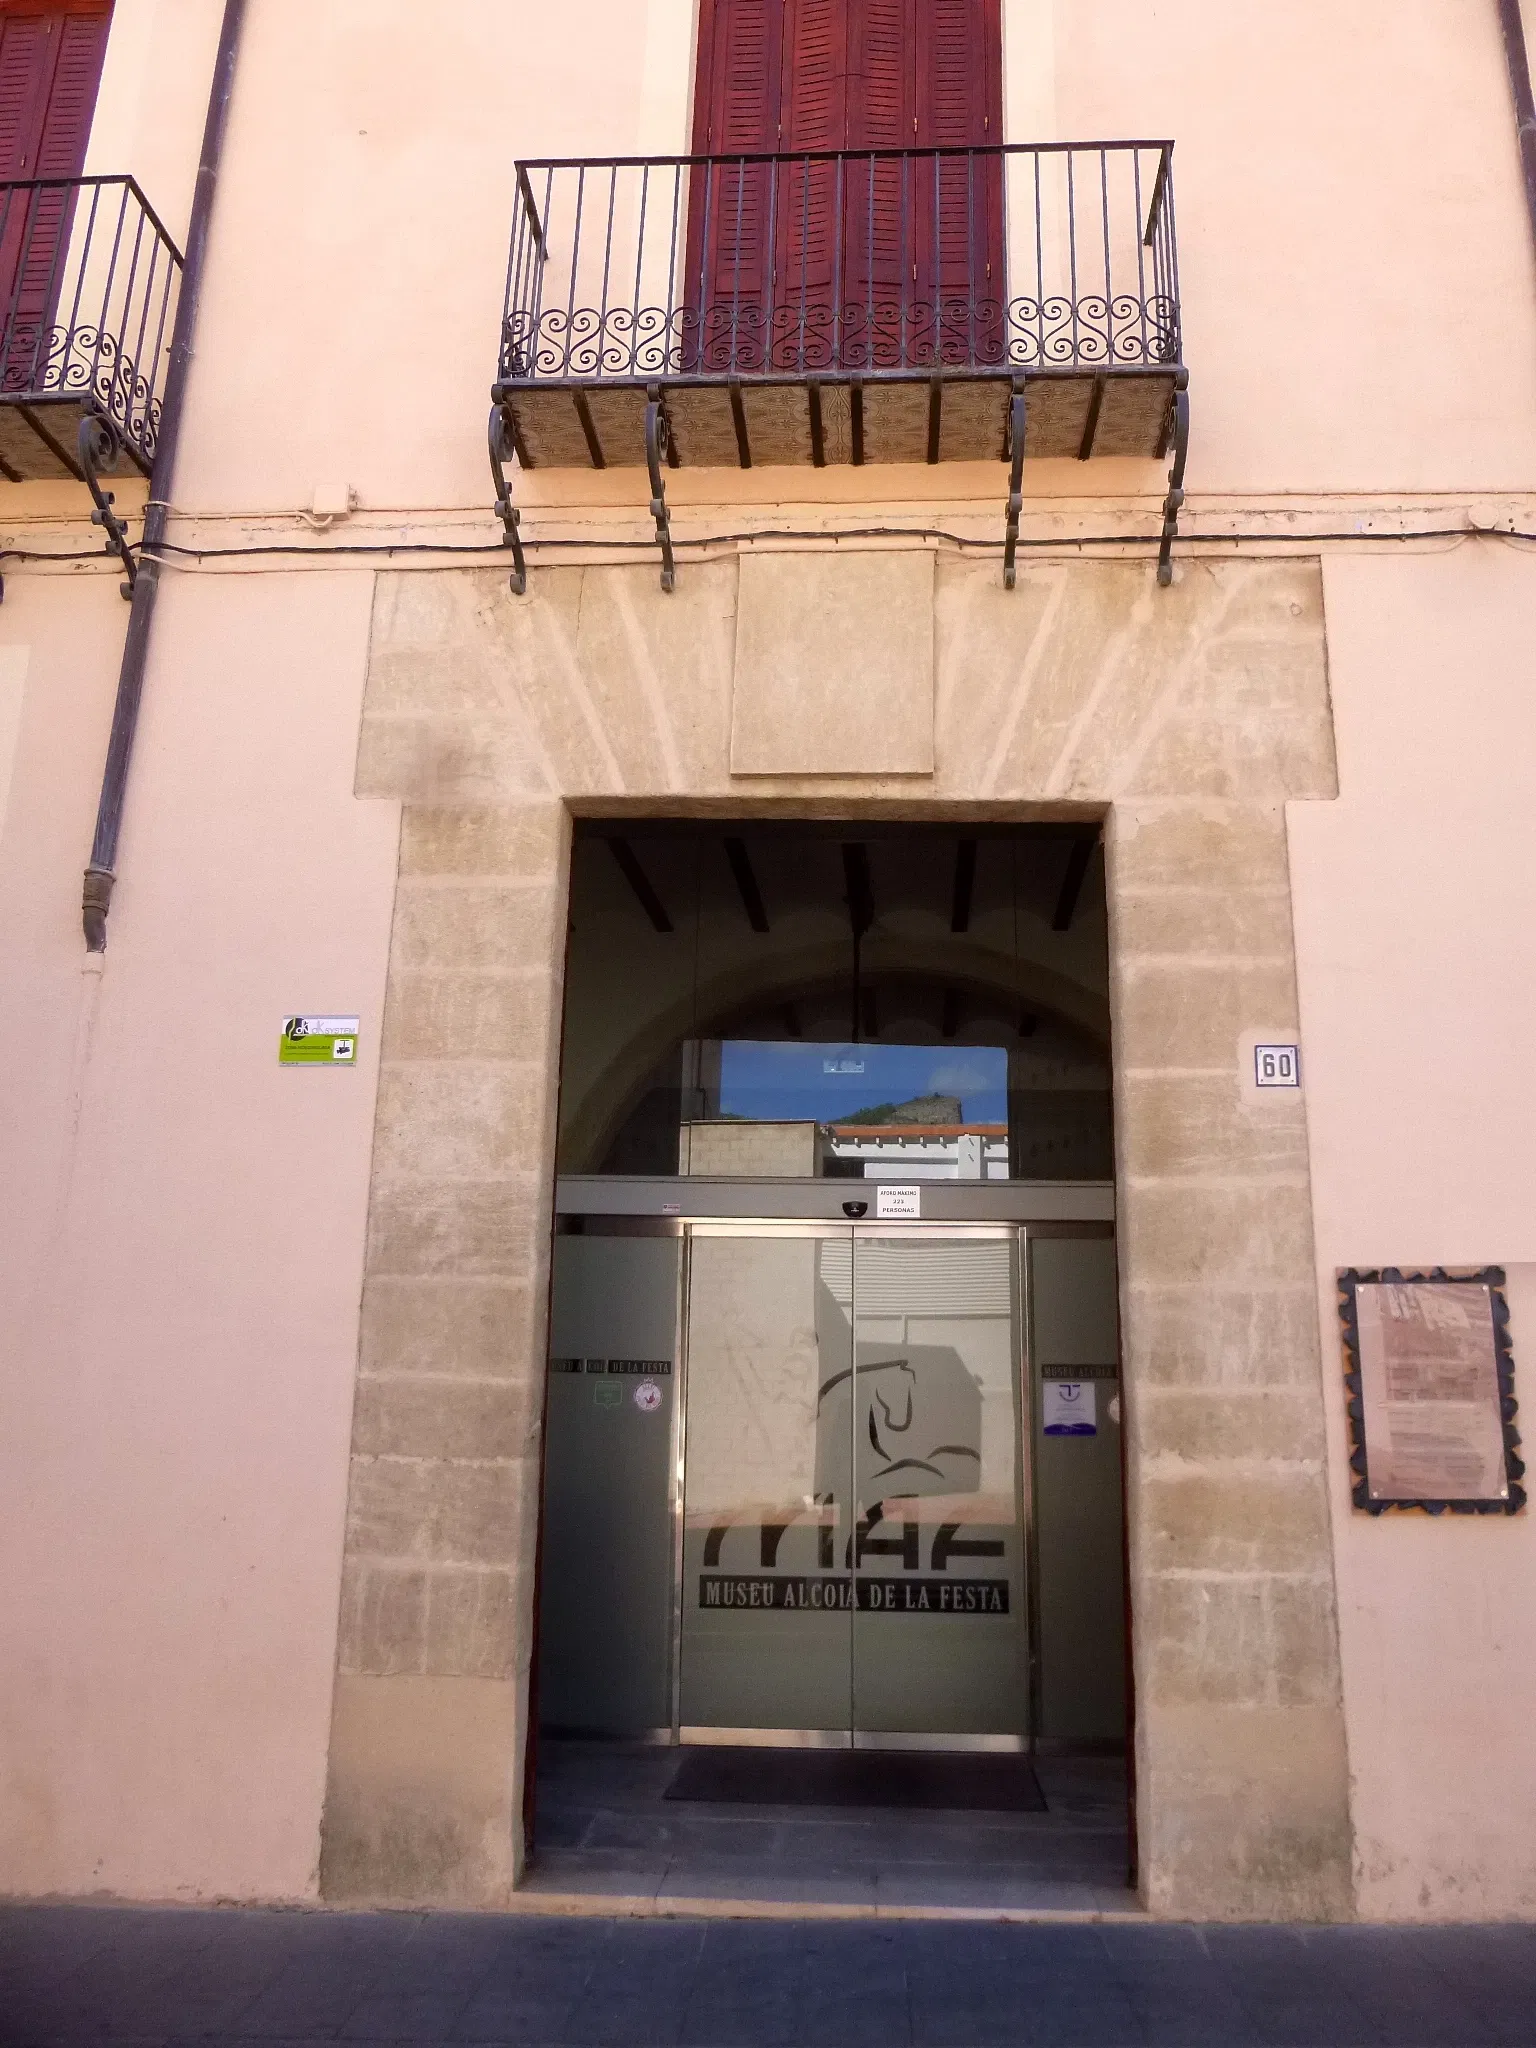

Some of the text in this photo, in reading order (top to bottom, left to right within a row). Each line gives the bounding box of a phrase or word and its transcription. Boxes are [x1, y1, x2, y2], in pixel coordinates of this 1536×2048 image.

[1263, 1053, 1291, 1077] 60
[612, 1361, 625, 1373] DE
[627, 1361, 638, 1373] LA
[642, 1361, 669, 1374] FESTA
[706, 1581, 775, 1606] MUSEU
[870, 1584, 896, 1608] DE
[905, 1585, 930, 1609] LA
[940, 1586, 1003, 1610] FESTA
